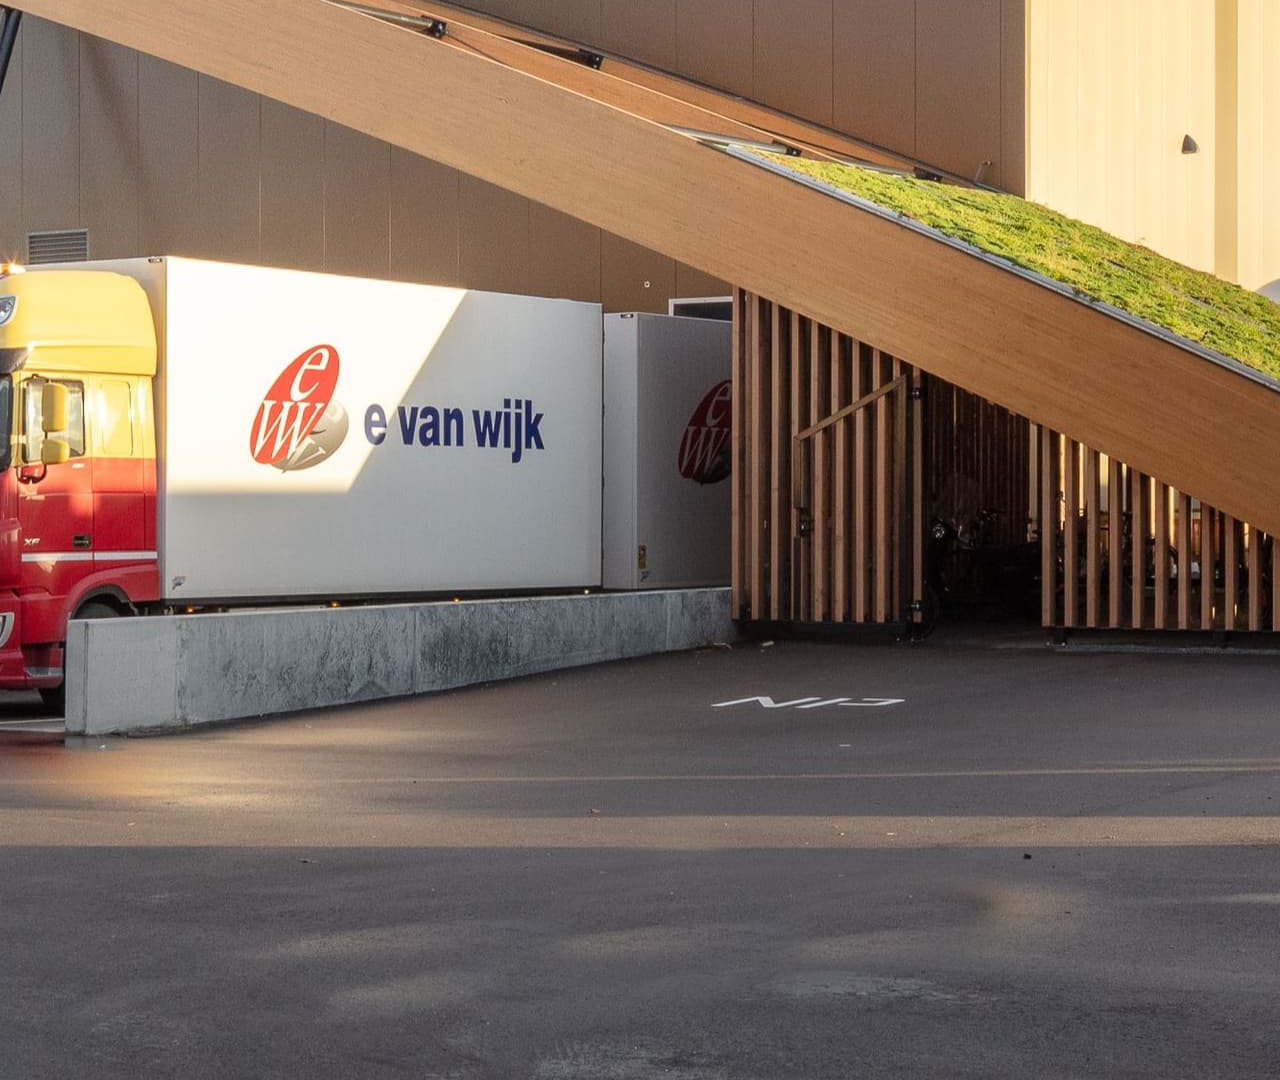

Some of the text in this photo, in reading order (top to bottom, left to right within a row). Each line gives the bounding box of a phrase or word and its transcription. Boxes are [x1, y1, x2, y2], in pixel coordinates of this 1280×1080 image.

[364, 398, 545, 463] e van wijk
